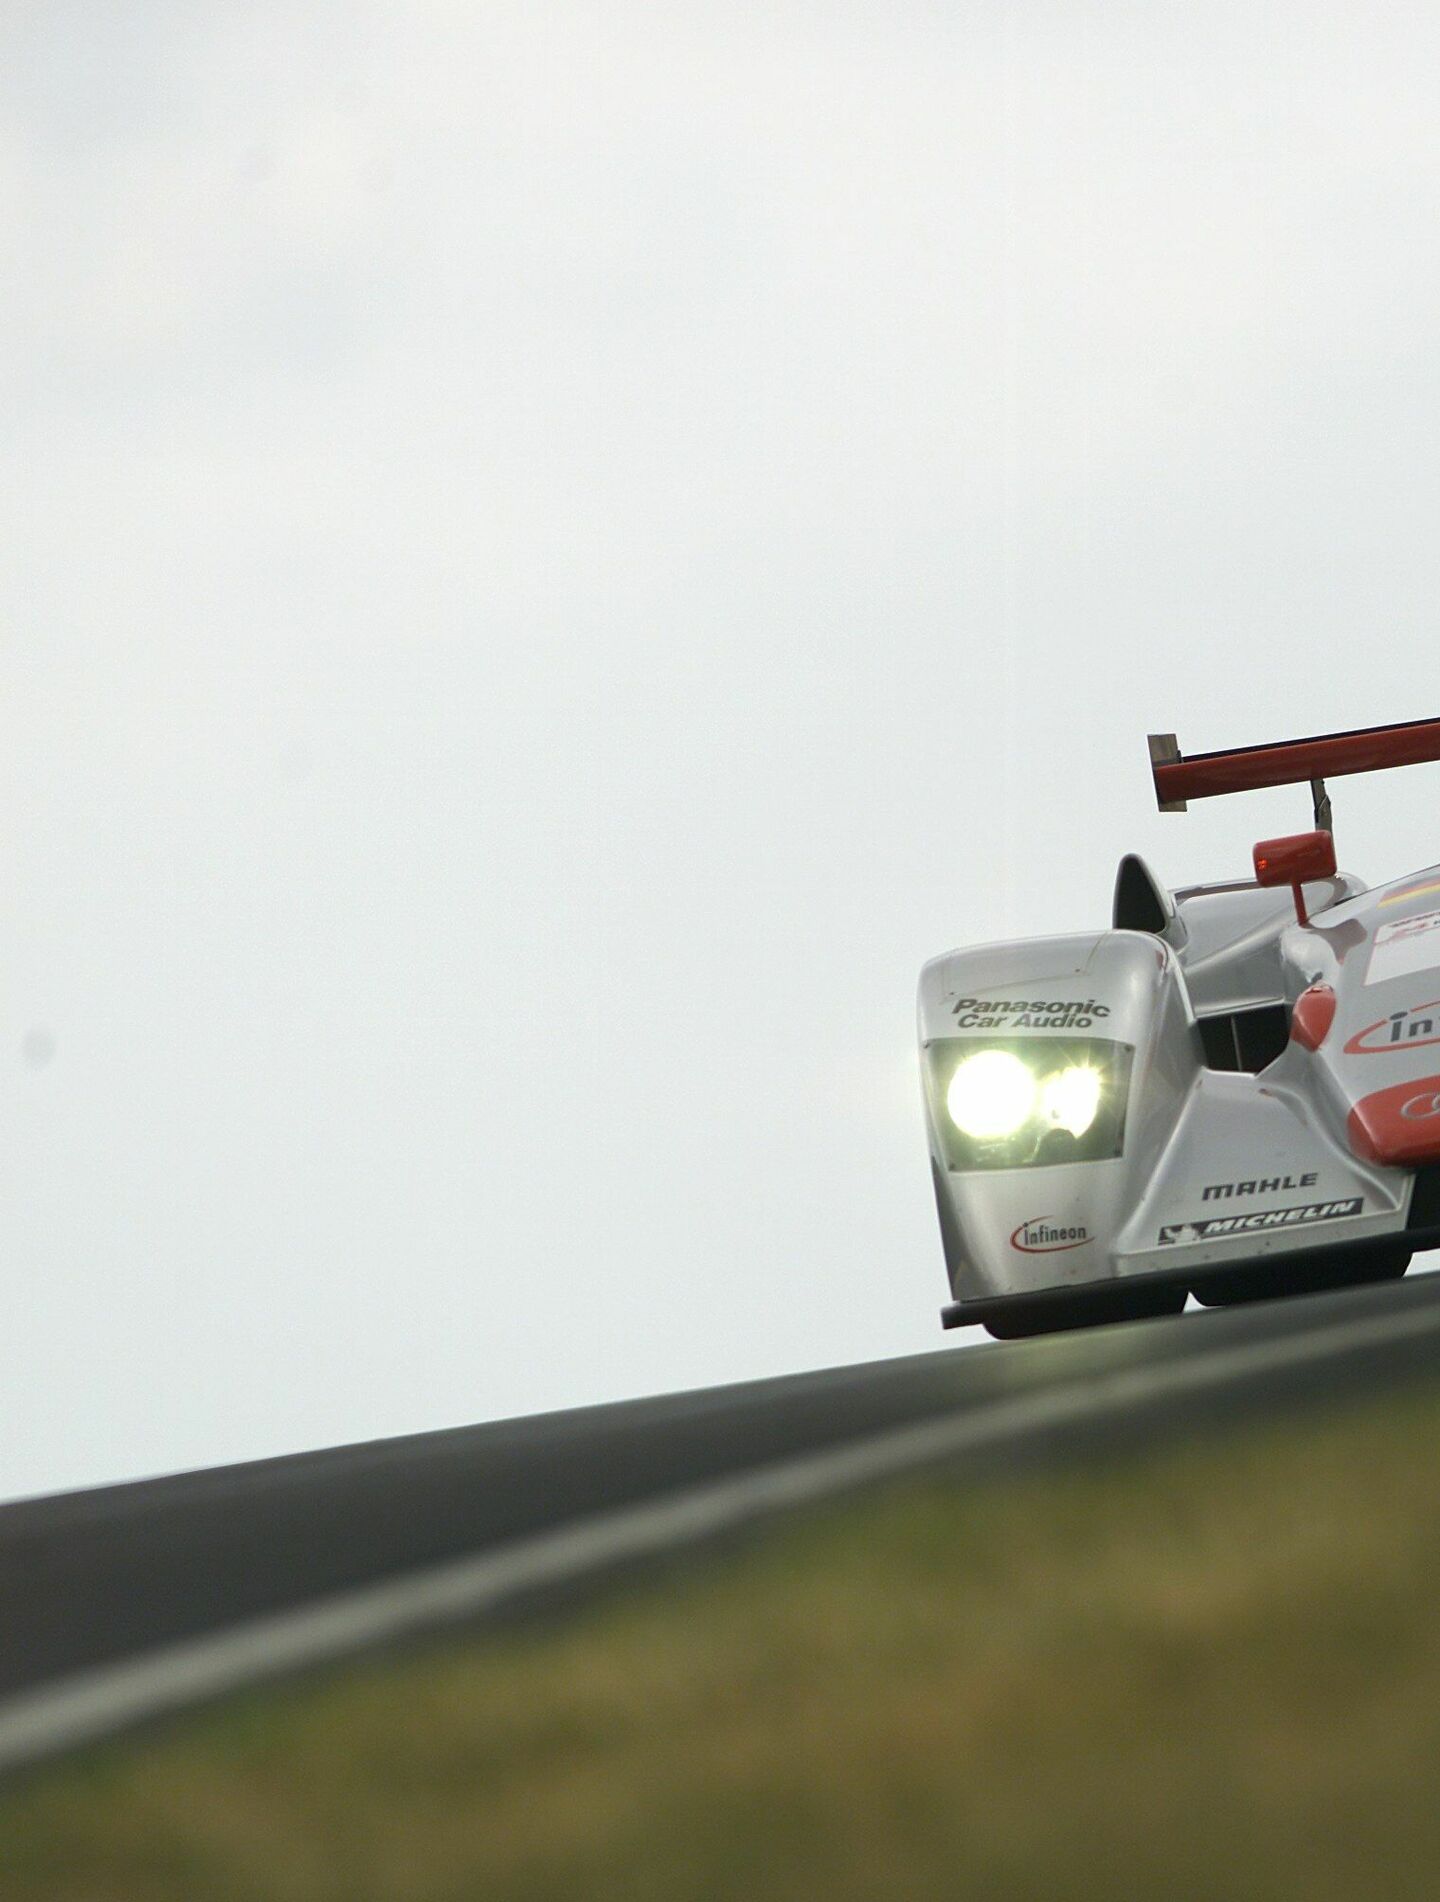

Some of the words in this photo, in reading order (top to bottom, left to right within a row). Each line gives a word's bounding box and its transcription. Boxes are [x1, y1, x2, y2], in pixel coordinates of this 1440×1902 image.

[952, 998, 1111, 1018] Panasonic
[958, 1014, 1008, 1028] Car
[1011, 1013, 1092, 1028] Audio
[1202, 1172, 1318, 1201] MAHLE
[1204, 1200, 1355, 1233] MICHELIN
